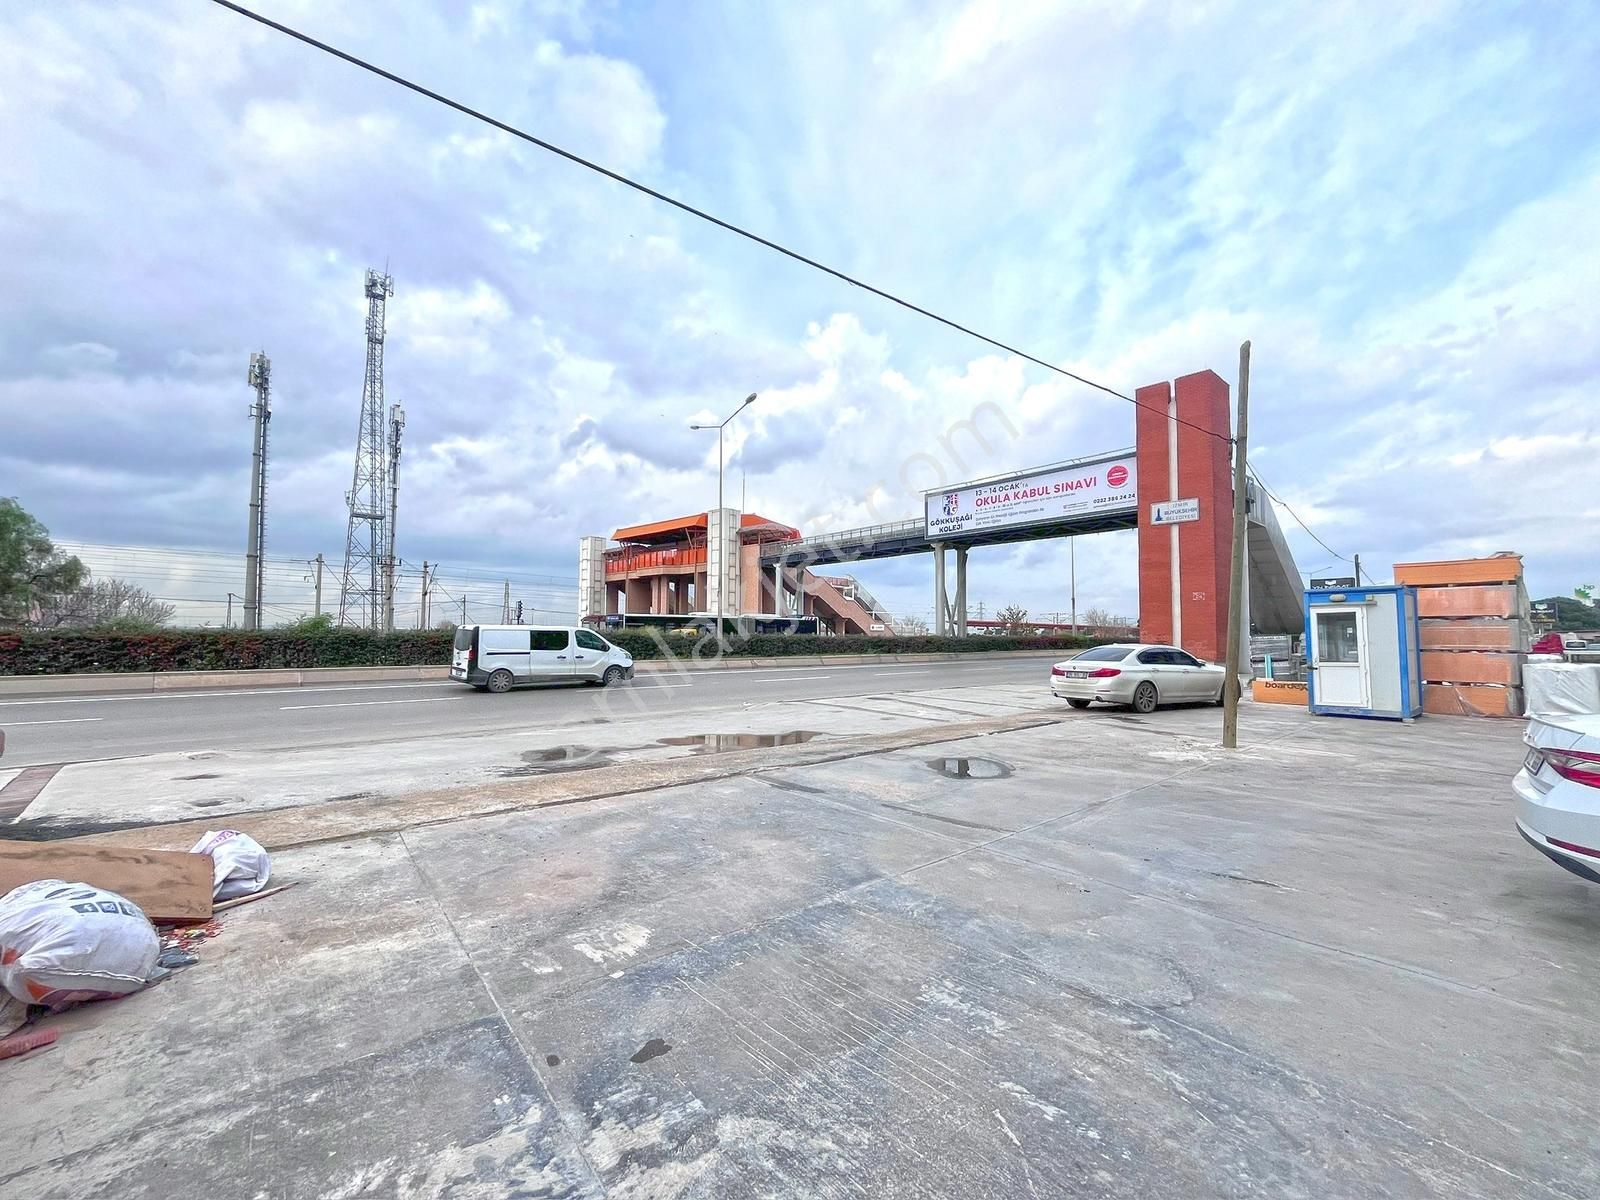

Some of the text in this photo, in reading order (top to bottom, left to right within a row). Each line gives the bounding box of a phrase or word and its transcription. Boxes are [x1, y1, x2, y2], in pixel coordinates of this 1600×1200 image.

[975, 494, 1011, 507] OKULA
[1013, 486, 1050, 501] KABUL
[1053, 476, 1097, 493] SINAVI
[975, 489, 983, 497] 13
[930, 513, 973, 527] GÖKKUŞAĞI
